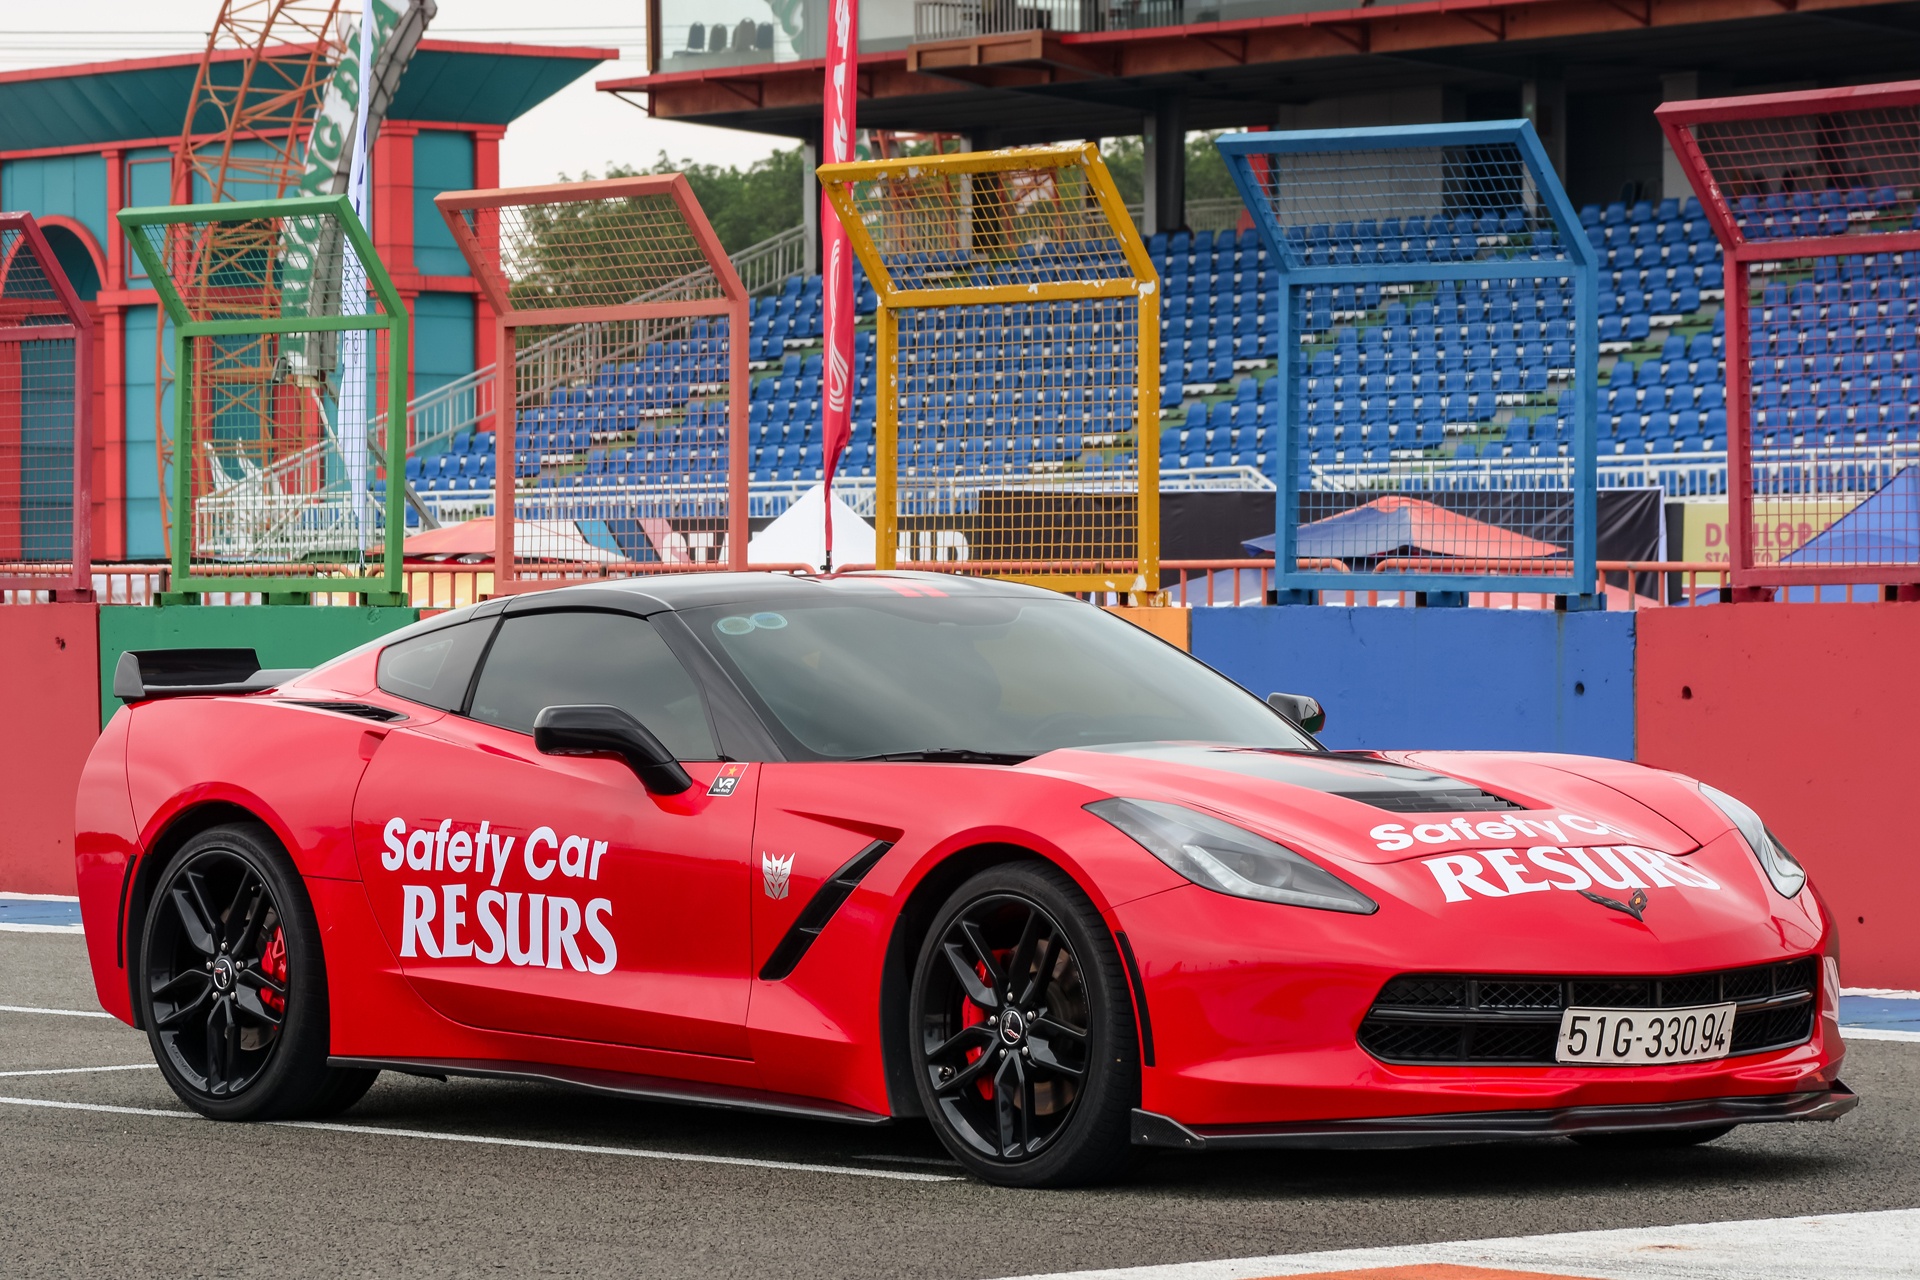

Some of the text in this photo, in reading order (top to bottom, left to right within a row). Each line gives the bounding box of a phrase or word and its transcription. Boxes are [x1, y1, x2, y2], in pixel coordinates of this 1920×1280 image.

[1705, 522, 1812, 547] DLOP
[381, 817, 608, 887] Safety Car
[1370, 814, 1569, 850] Safety
[1421, 845, 1721, 903] RESURS
[400, 884, 618, 975] RESURS
[1567, 1011, 1727, 1058] 51G-330.94
